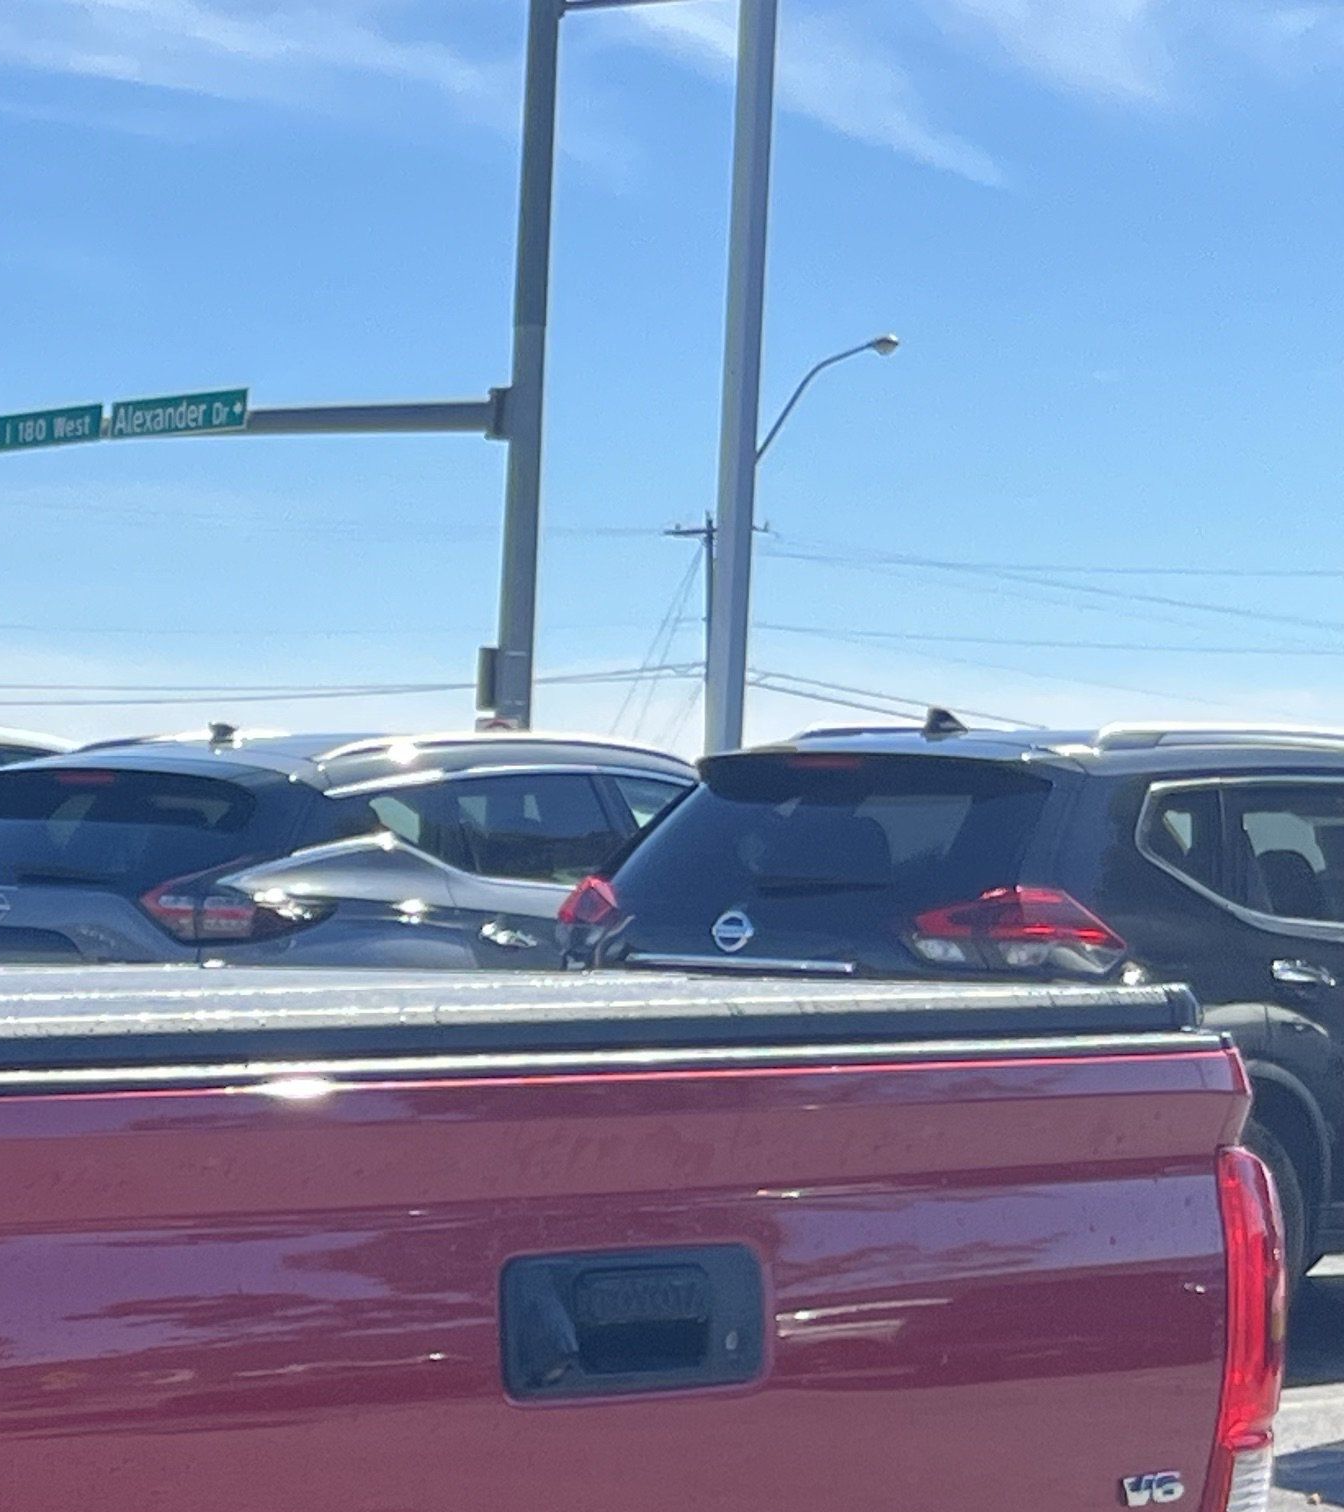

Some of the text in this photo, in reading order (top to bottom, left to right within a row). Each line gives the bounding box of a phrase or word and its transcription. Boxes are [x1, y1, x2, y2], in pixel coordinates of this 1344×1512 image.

[18, 419, 46, 442] 180
[53, 416, 91, 439] West
[115, 402, 230, 434] Alexander Dr
[1122, 1470, 1184, 1508] V6
